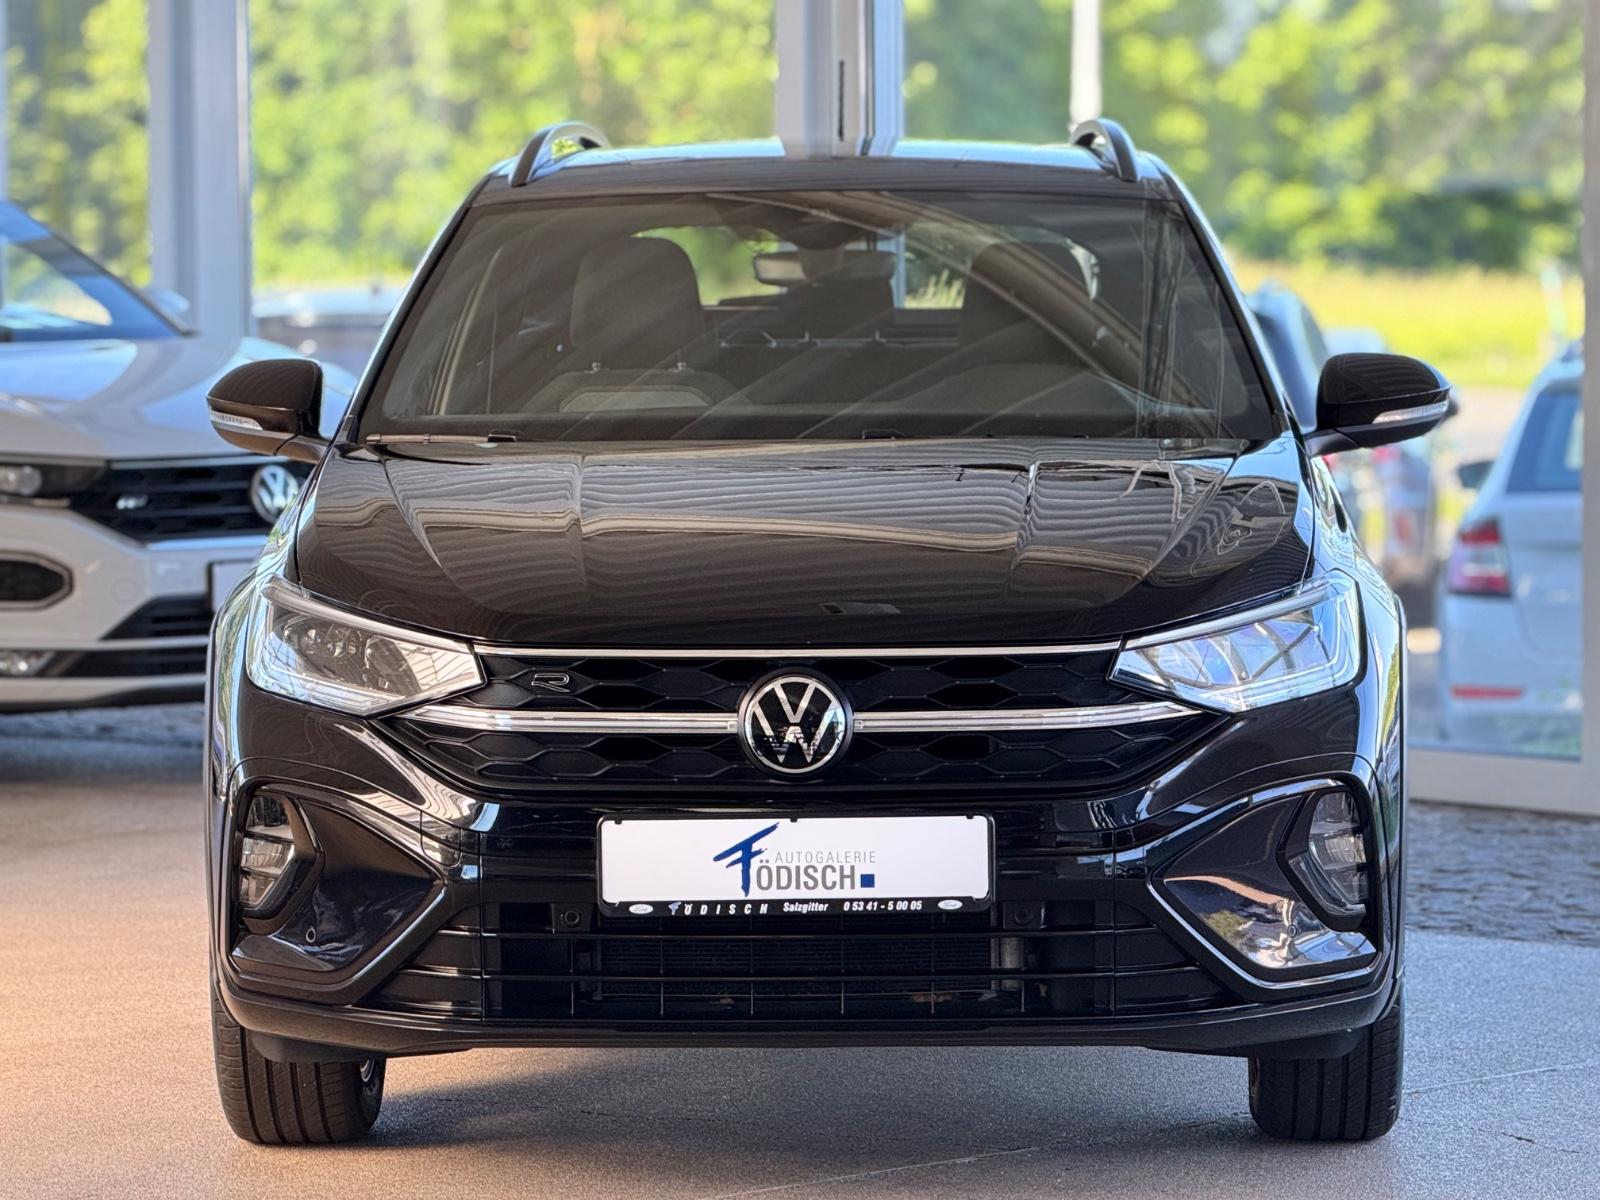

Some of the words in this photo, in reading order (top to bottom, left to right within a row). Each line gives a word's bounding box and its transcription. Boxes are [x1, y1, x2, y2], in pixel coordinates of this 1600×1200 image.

[531, 672, 570, 693] R
[750, 680, 841, 765] VW
[775, 851, 876, 864] AUTOGALERIE
[783, 902, 829, 914] Salzgitter
